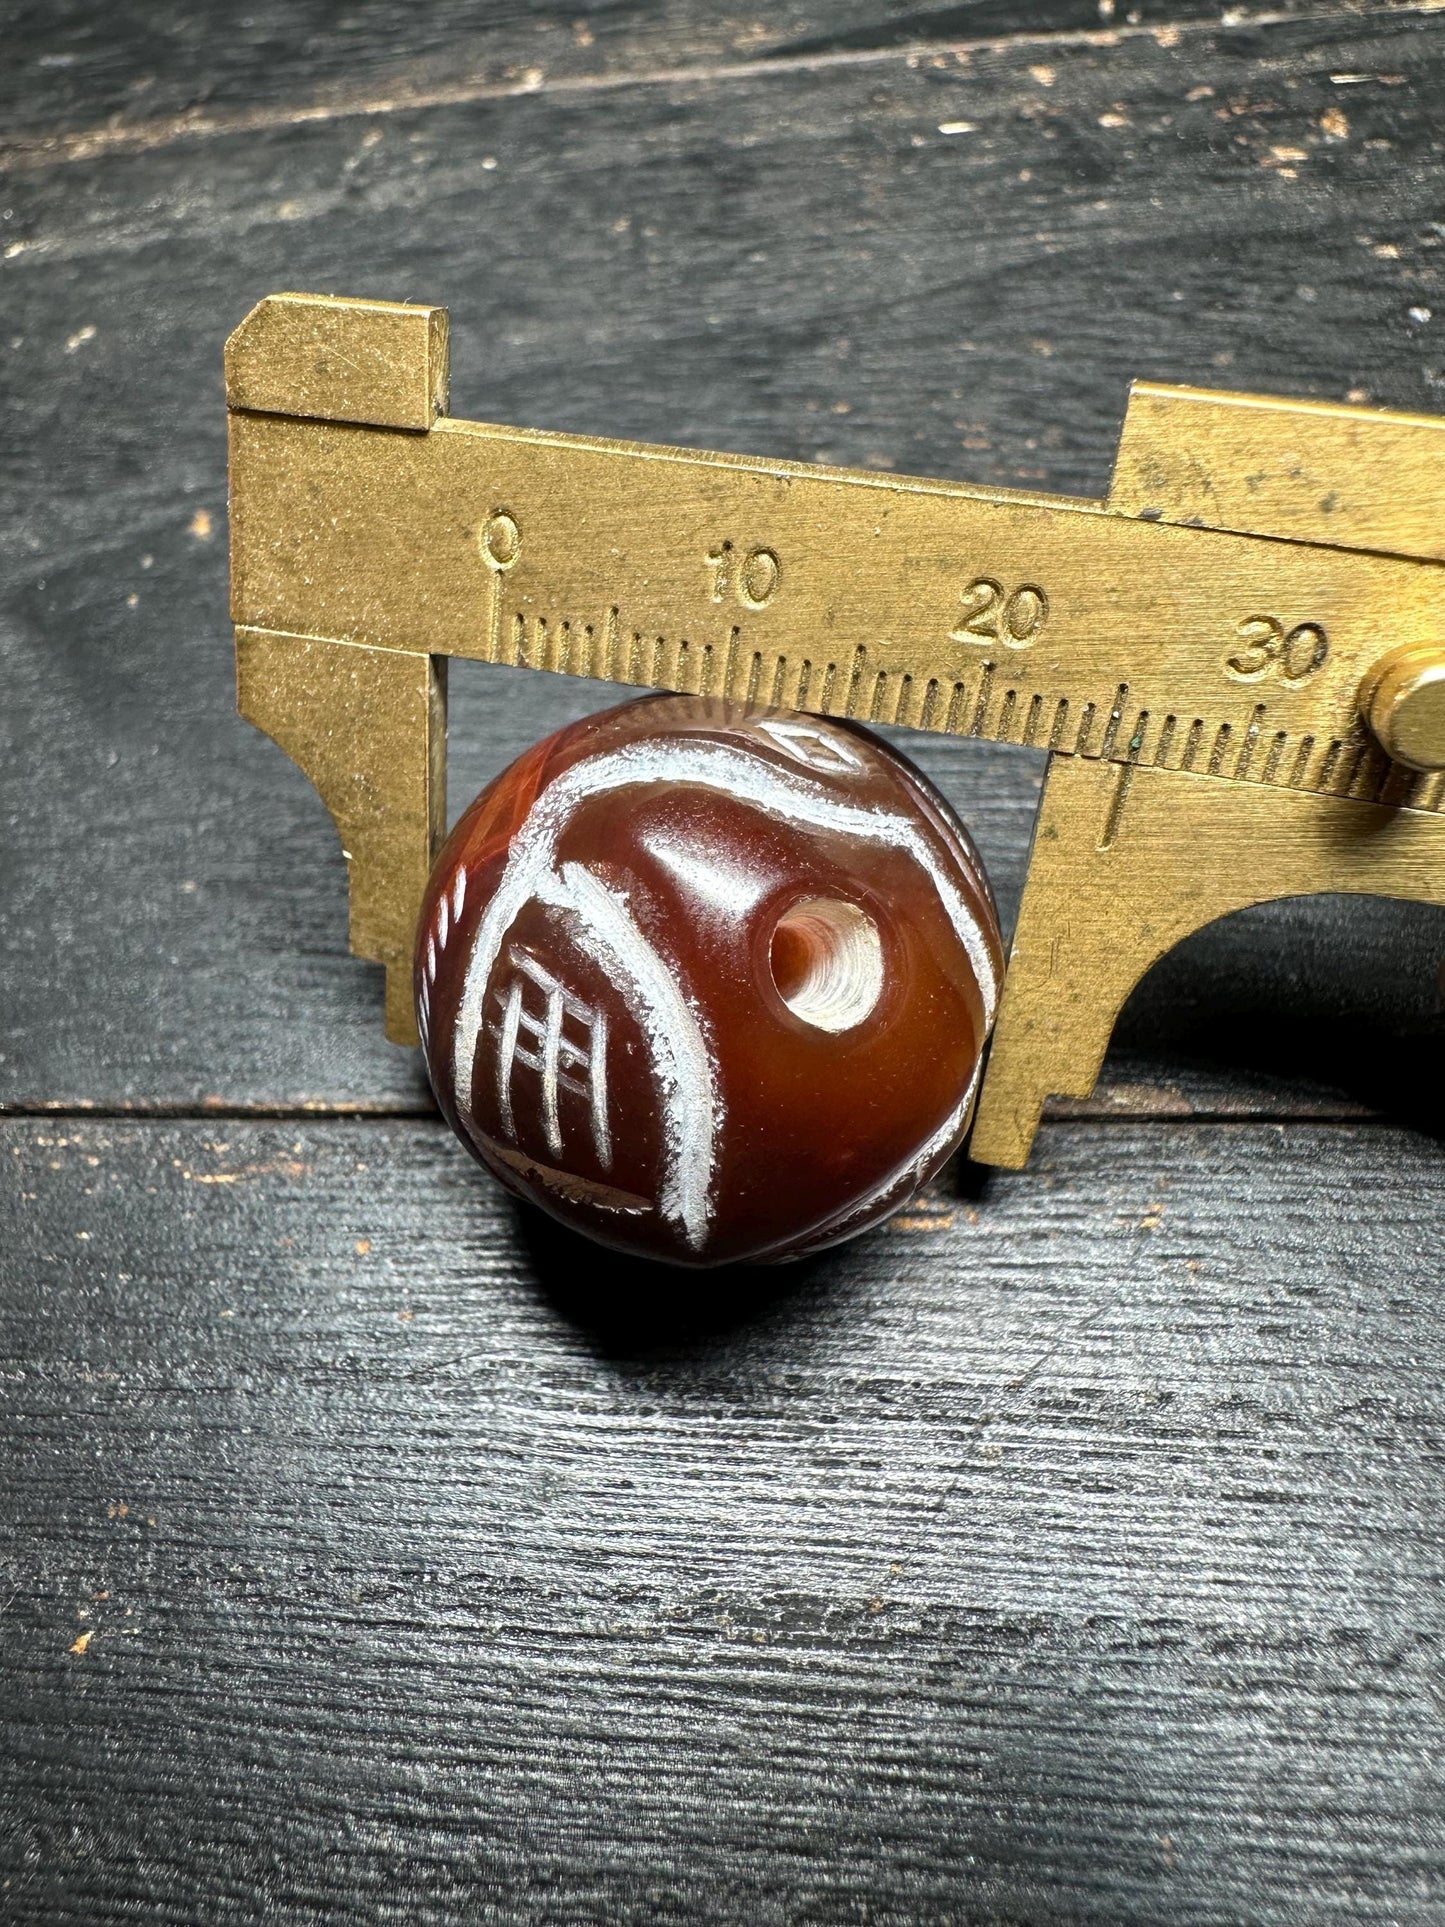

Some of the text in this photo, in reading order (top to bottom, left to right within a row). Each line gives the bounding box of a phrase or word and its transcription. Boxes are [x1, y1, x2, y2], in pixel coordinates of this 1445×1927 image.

[479, 509, 1329, 688] 0 10 20 30
